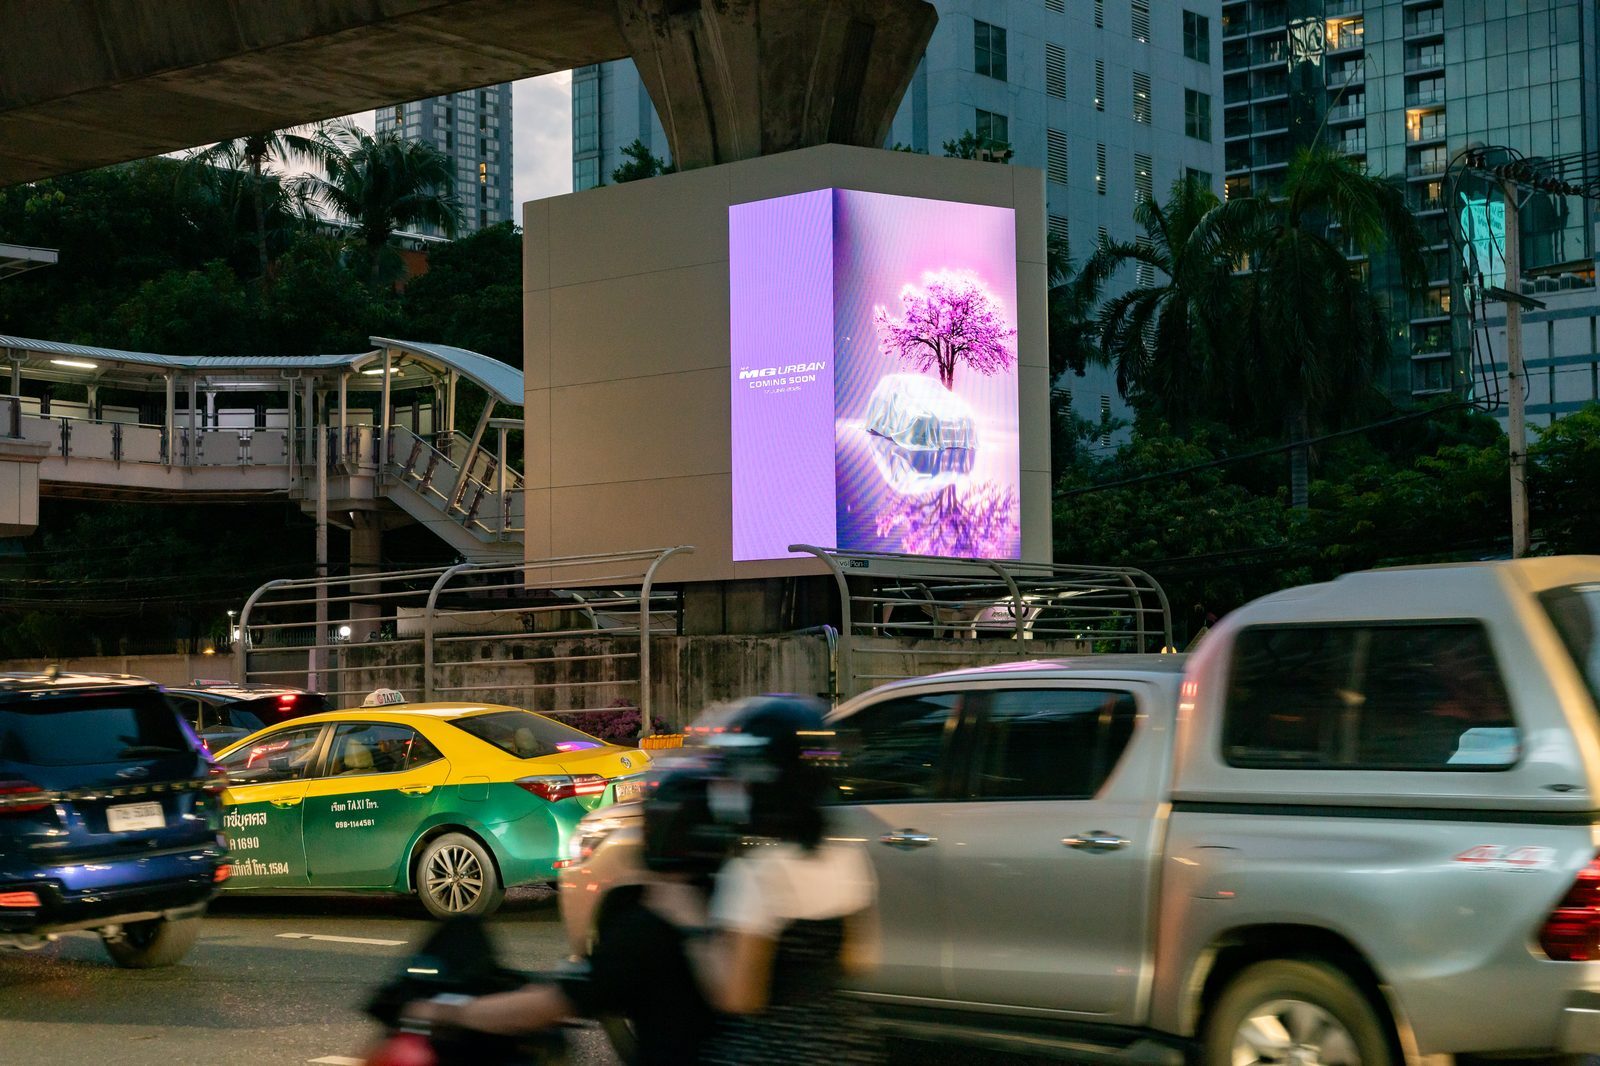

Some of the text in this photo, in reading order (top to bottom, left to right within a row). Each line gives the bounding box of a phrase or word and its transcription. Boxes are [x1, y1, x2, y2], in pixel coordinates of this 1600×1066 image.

[739, 361, 826, 379] MG URBAN
[749, 374, 816, 389] COMING SOON
[383, 692, 396, 704] TAXI
[347, 799, 365, 810] TAXI
[223, 807, 267, 831] กซี่บุคคล
[237, 836, 260, 850] 1690
